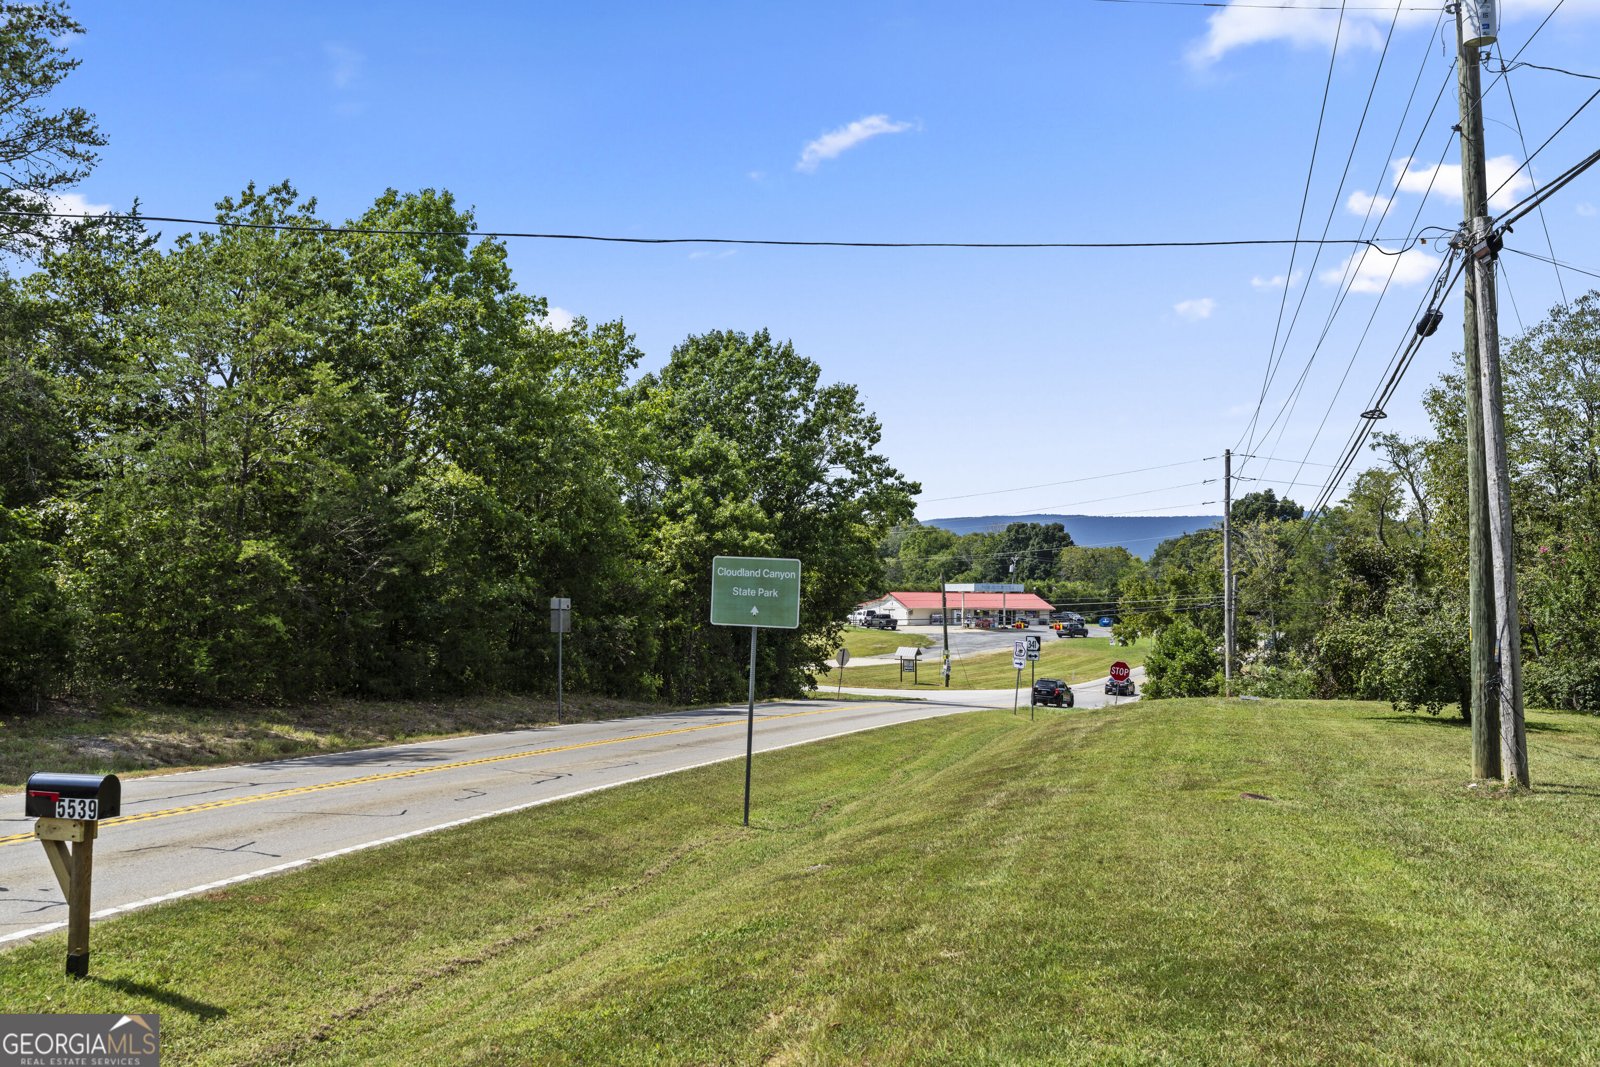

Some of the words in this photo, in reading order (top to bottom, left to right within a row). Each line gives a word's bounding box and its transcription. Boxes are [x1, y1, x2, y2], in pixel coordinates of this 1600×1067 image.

[717, 567, 761, 578] Cloudland
[762, 568, 796, 580] Canyon
[732, 587, 756, 597] State
[758, 588, 779, 598] Park
[1027, 640, 1037, 649] 341
[1111, 666, 1129, 676] STOP
[57, 799, 97, 819] 5539
